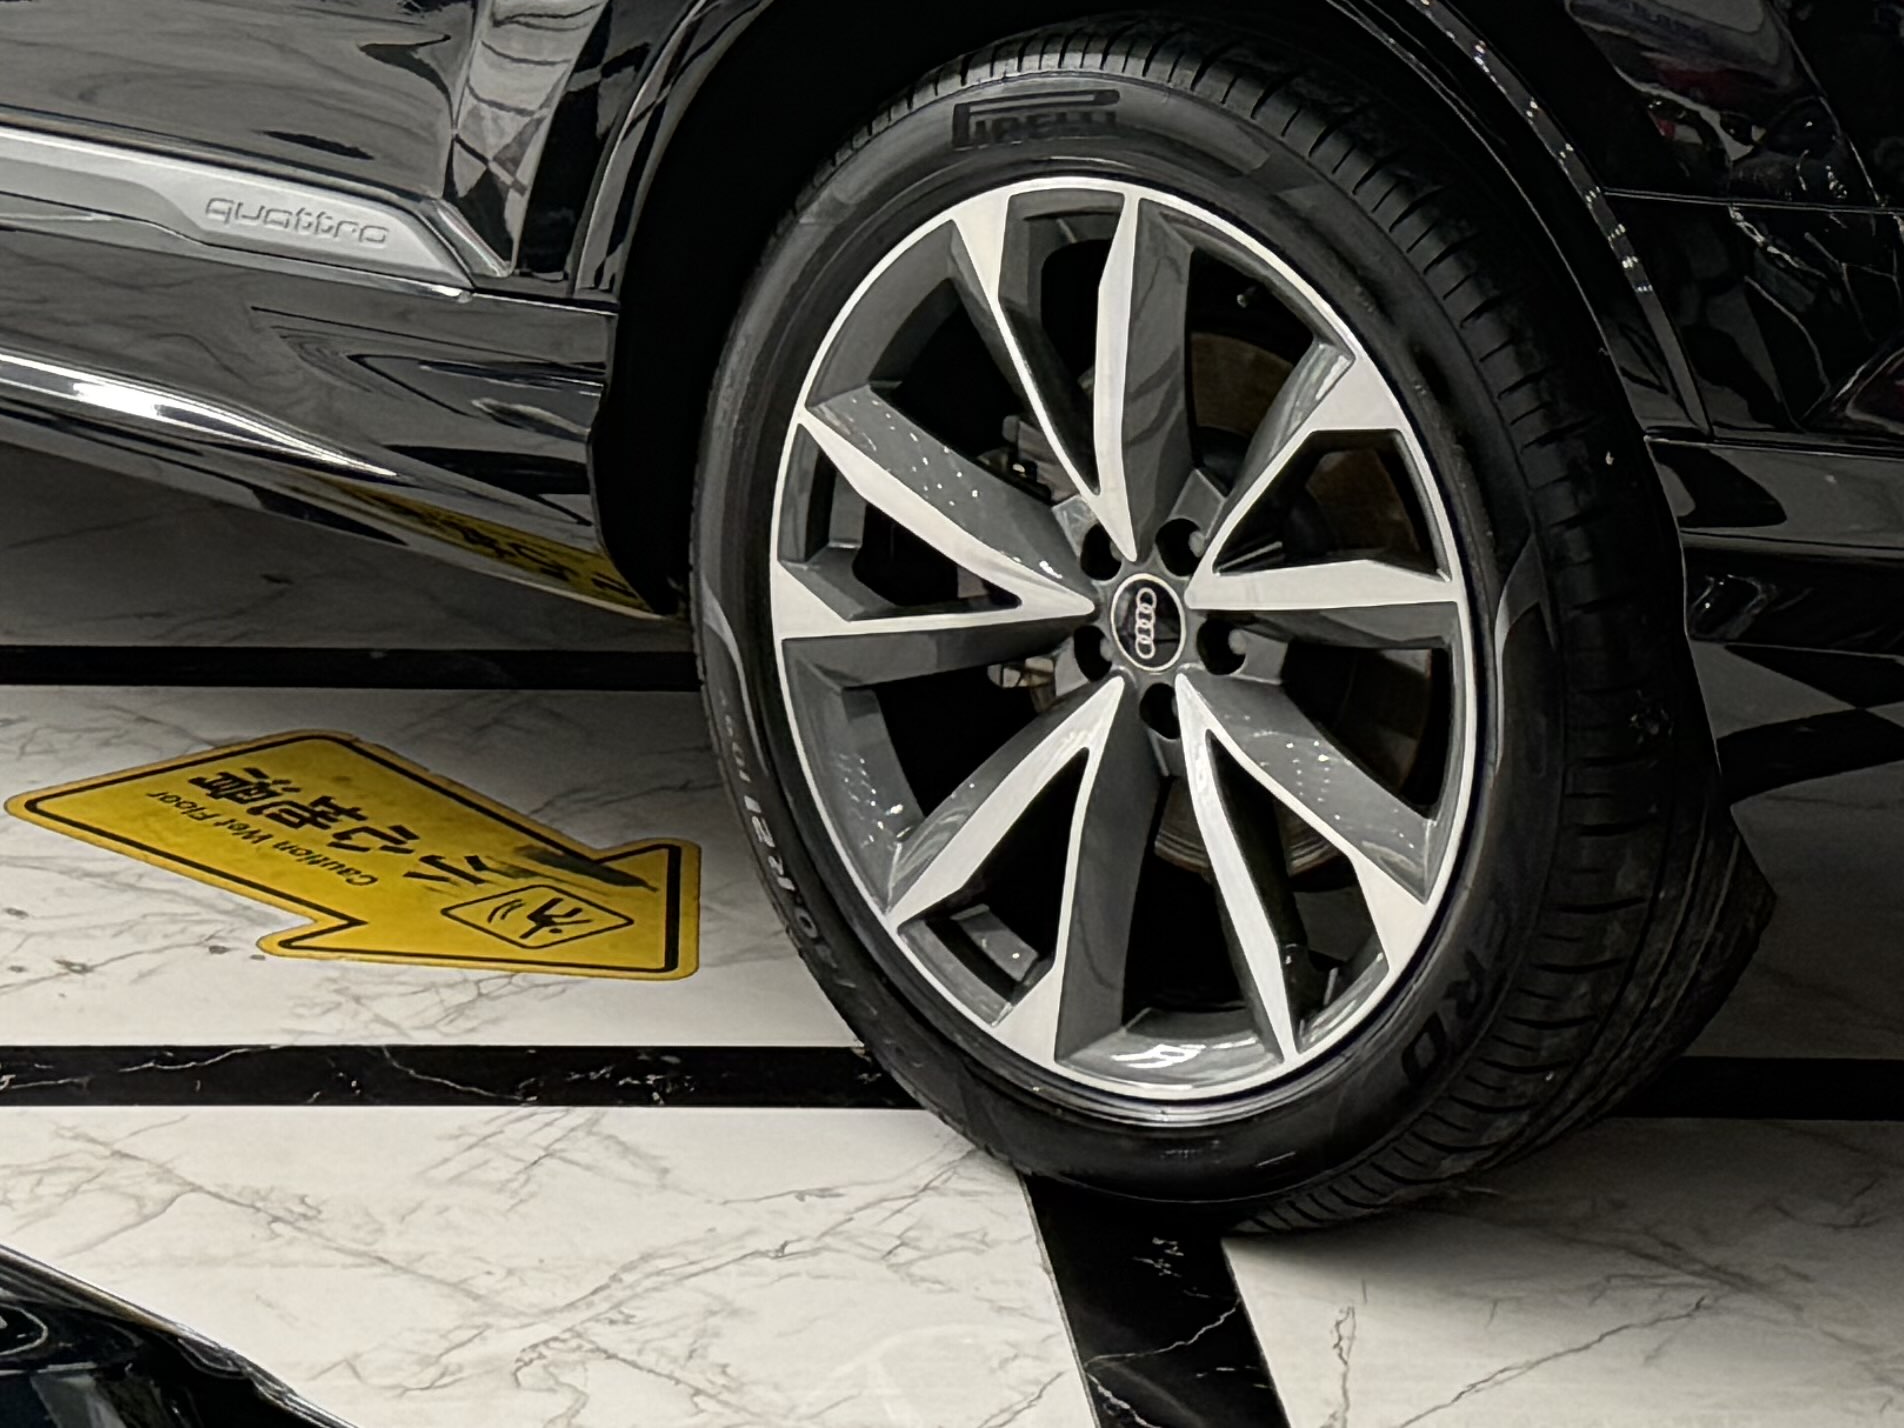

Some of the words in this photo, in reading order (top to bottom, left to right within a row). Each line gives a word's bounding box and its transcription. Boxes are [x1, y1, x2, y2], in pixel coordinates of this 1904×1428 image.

[951, 88, 1122, 152] PIRELLI
[205, 195, 390, 249] quattro
[147, 789, 217, 825] Floor
[213, 816, 277, 850] Wet
[273, 840, 379, 888] Caution
